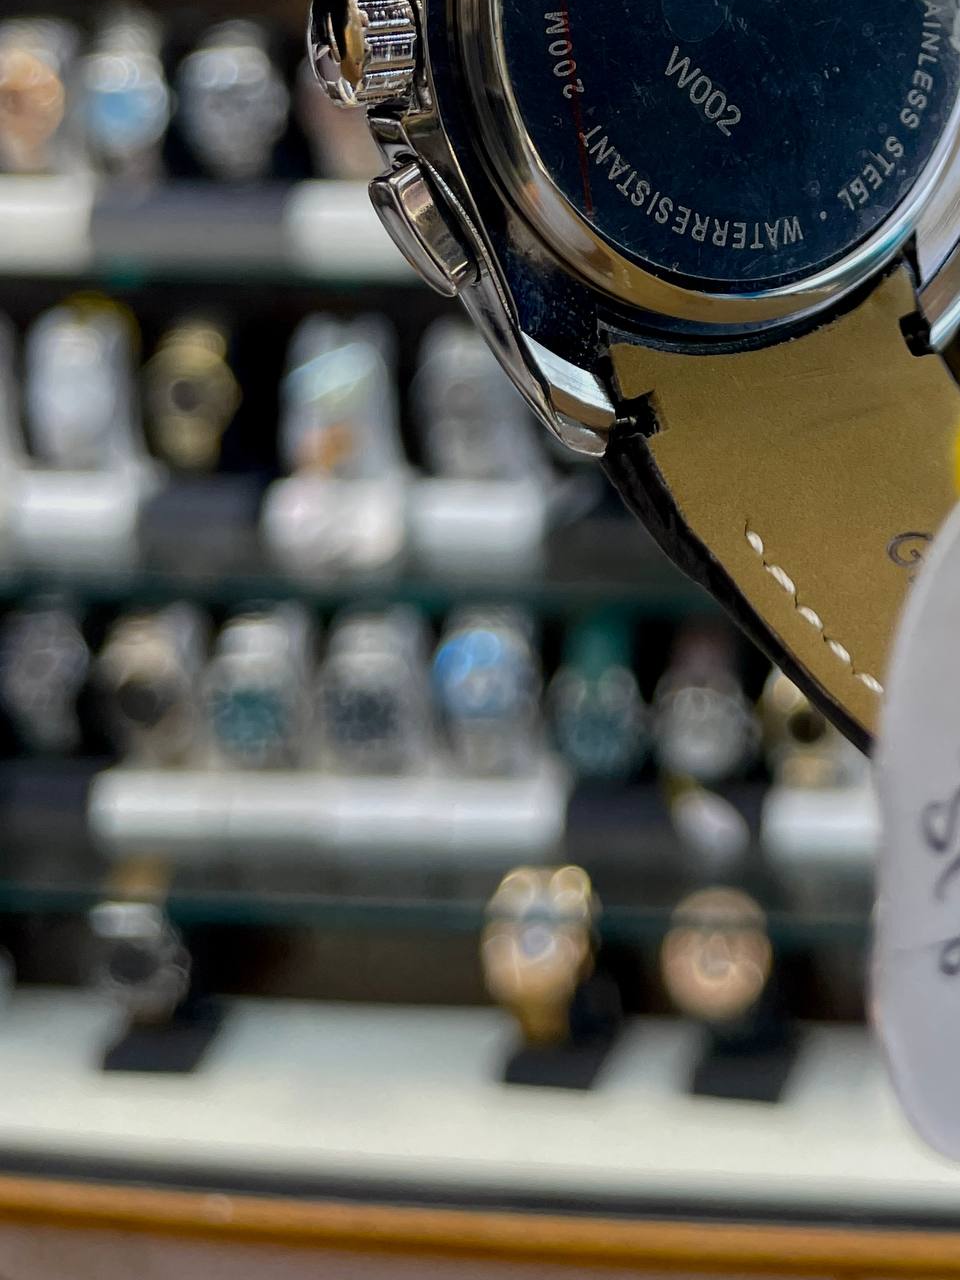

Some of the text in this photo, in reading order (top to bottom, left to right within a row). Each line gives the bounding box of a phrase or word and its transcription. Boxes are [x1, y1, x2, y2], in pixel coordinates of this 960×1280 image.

[544, 10, 805, 250] WATERRESISTANT 200M
[664, 45, 743, 137] W002
[837, 135, 904, 211] STEEL
